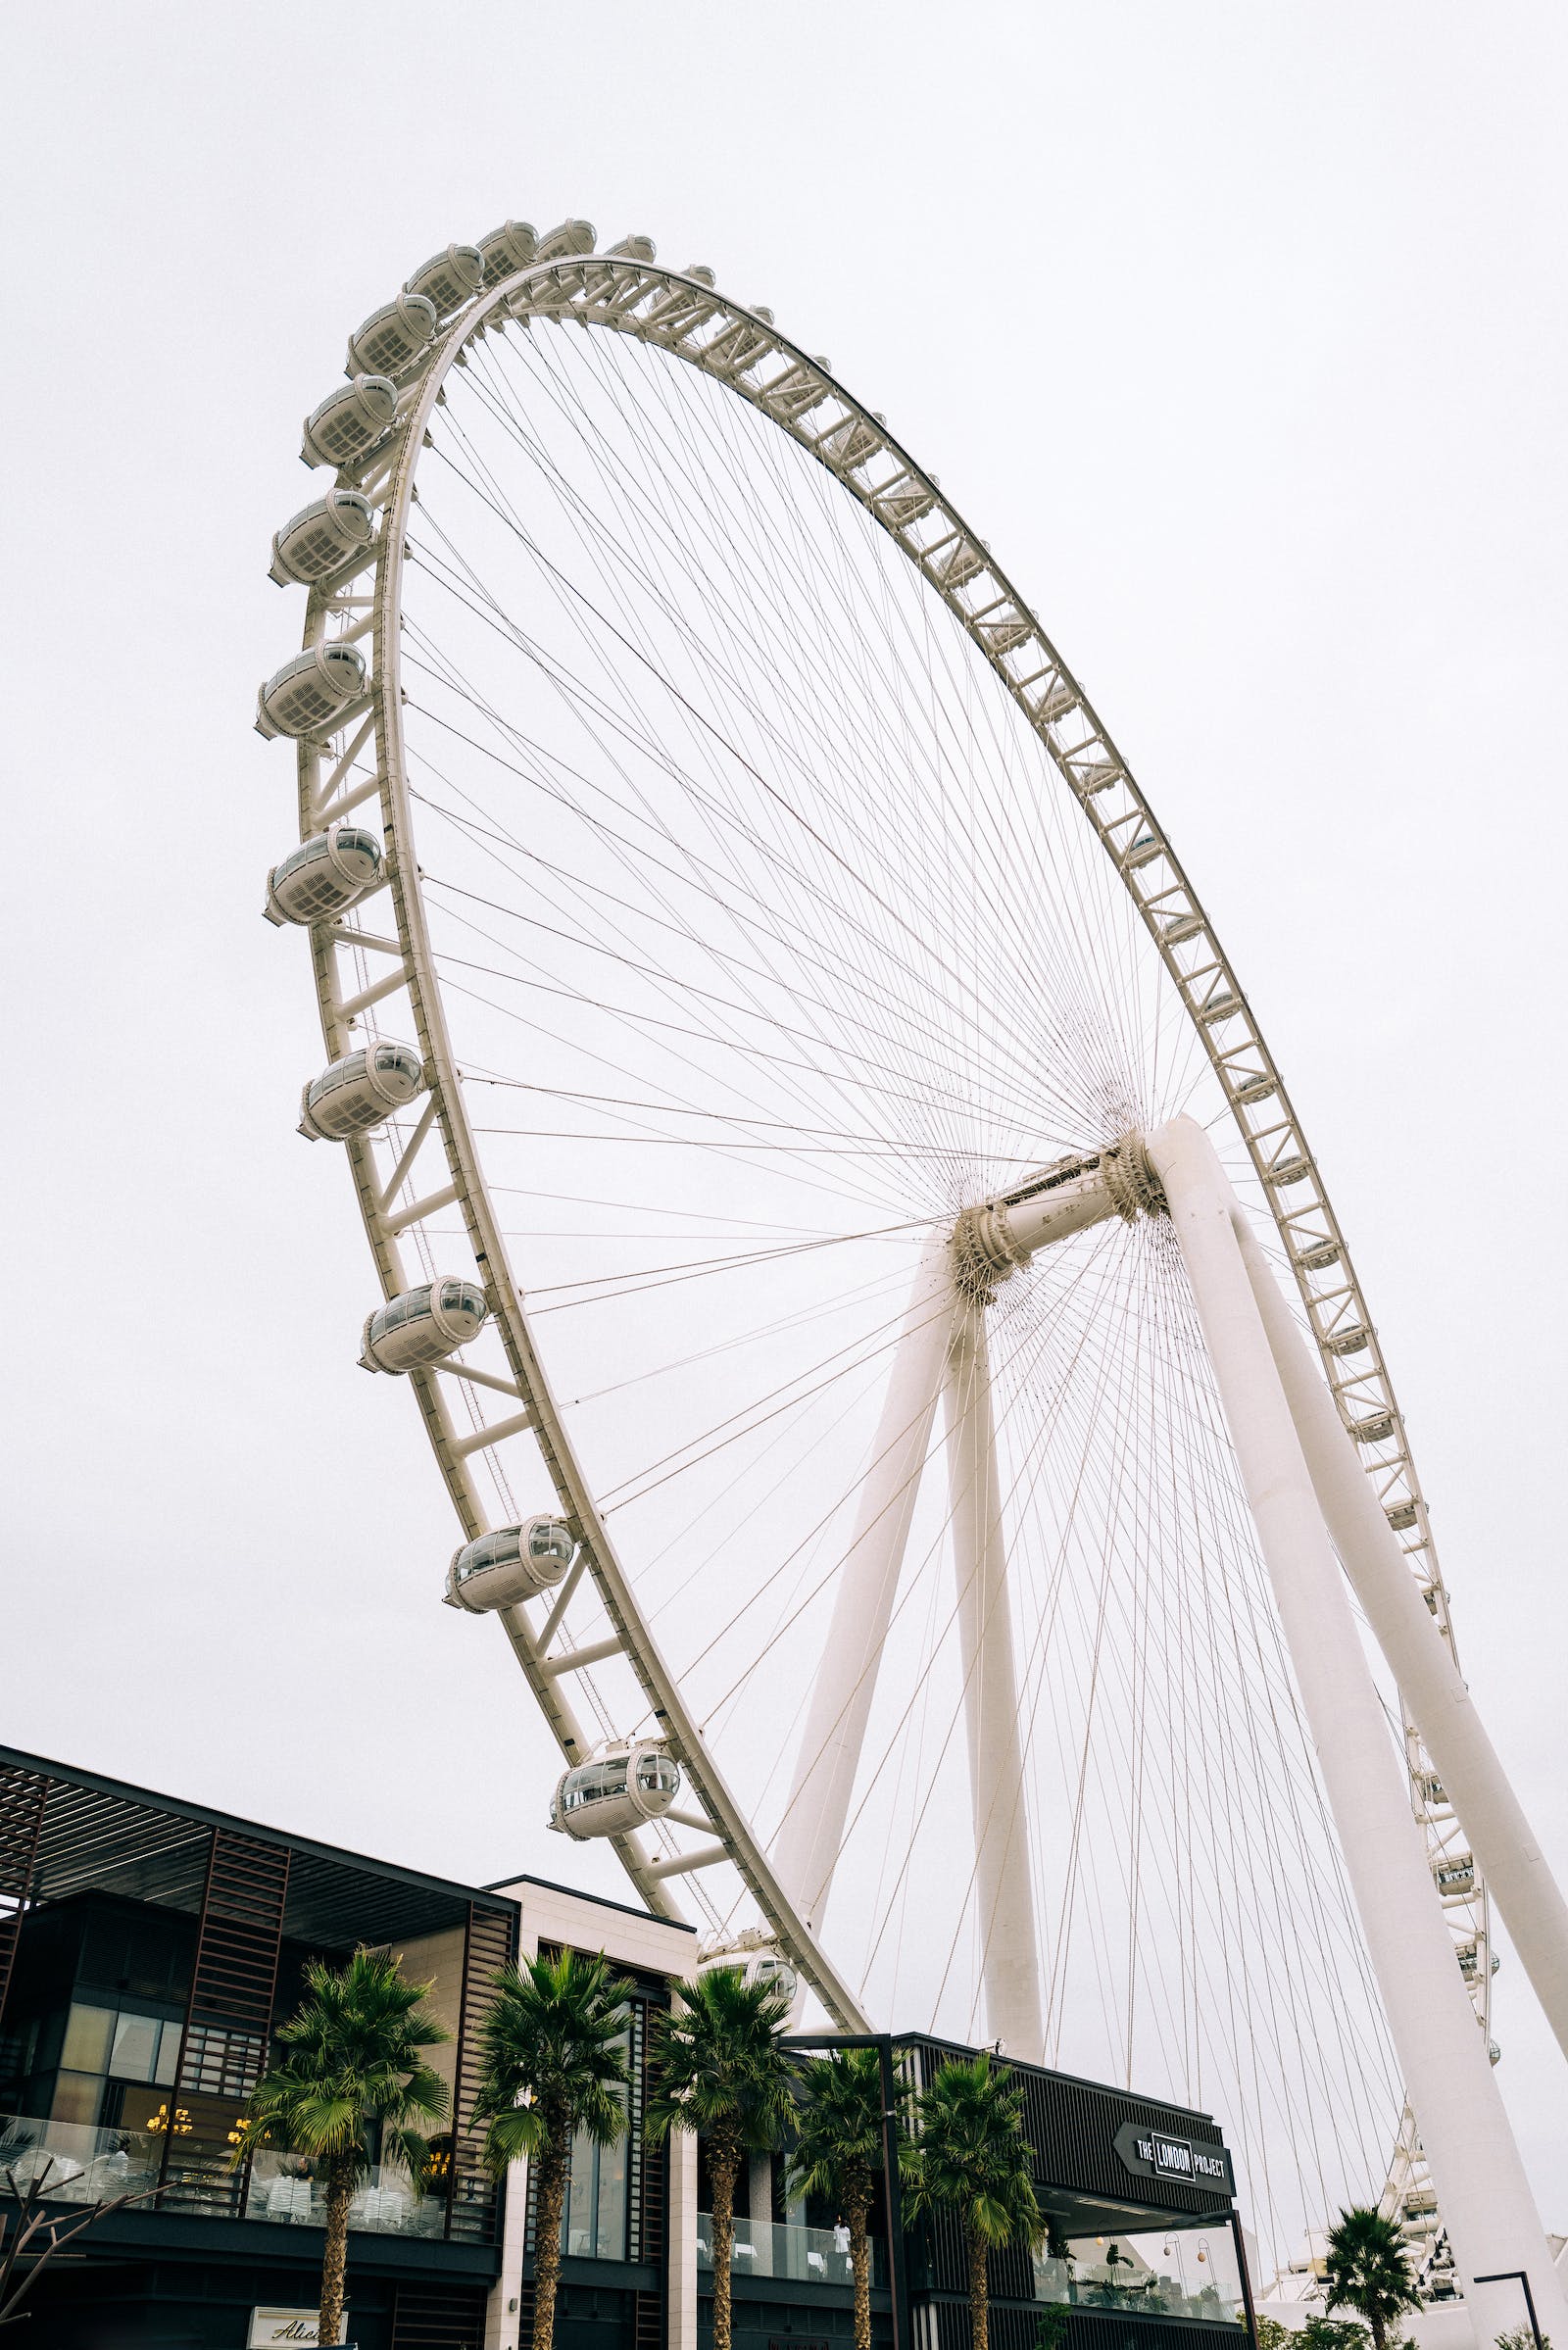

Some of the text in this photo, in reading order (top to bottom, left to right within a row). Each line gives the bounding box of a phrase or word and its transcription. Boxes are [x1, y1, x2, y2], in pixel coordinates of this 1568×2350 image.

[1138, 2139, 1225, 2178] THE LONDON PROJECT
